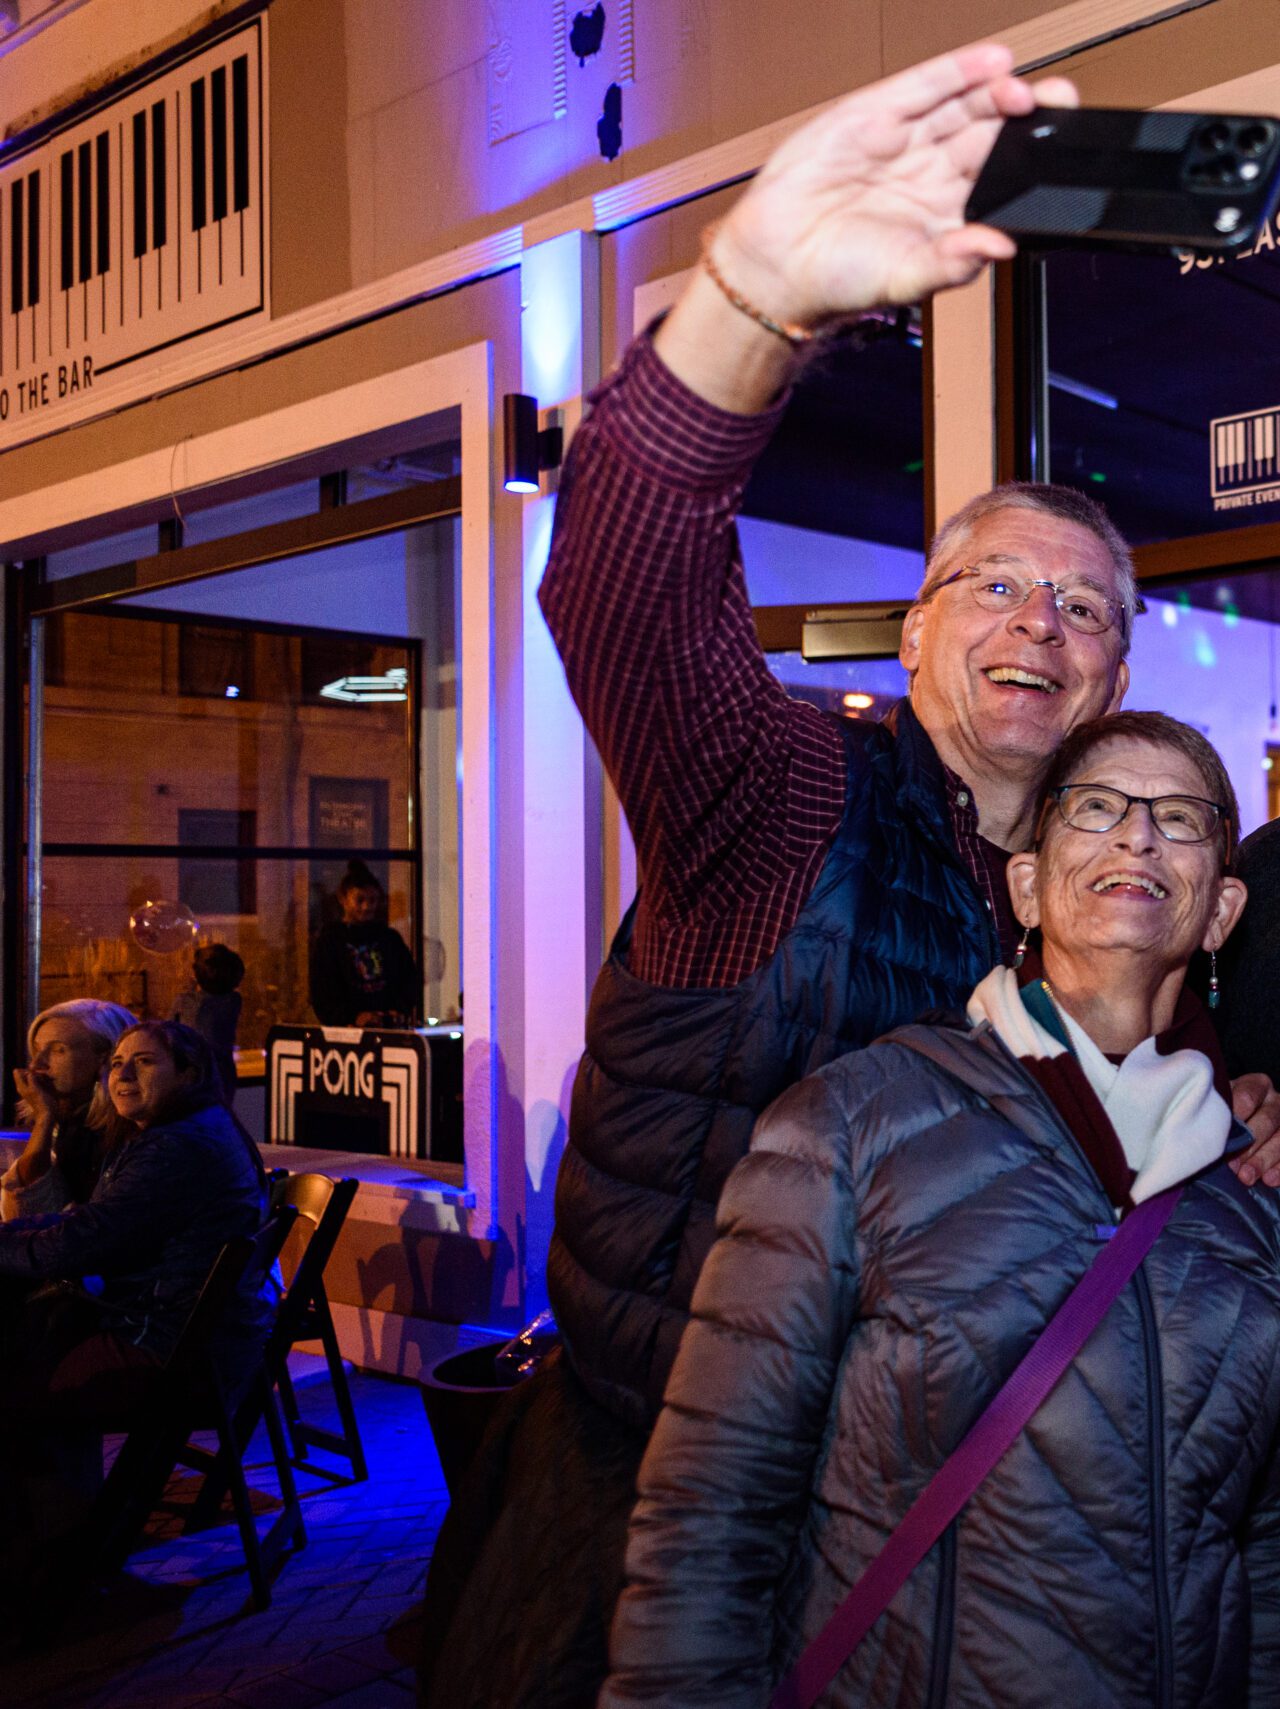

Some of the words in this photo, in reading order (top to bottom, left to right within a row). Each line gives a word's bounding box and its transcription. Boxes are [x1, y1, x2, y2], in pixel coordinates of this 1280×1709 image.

[0, 388, 9, 420] O
[17, 372, 49, 414] THE
[58, 355, 92, 398] BAR
[1213, 492, 1254, 513] PRIVATE
[308, 1047, 375, 1100] PONG
